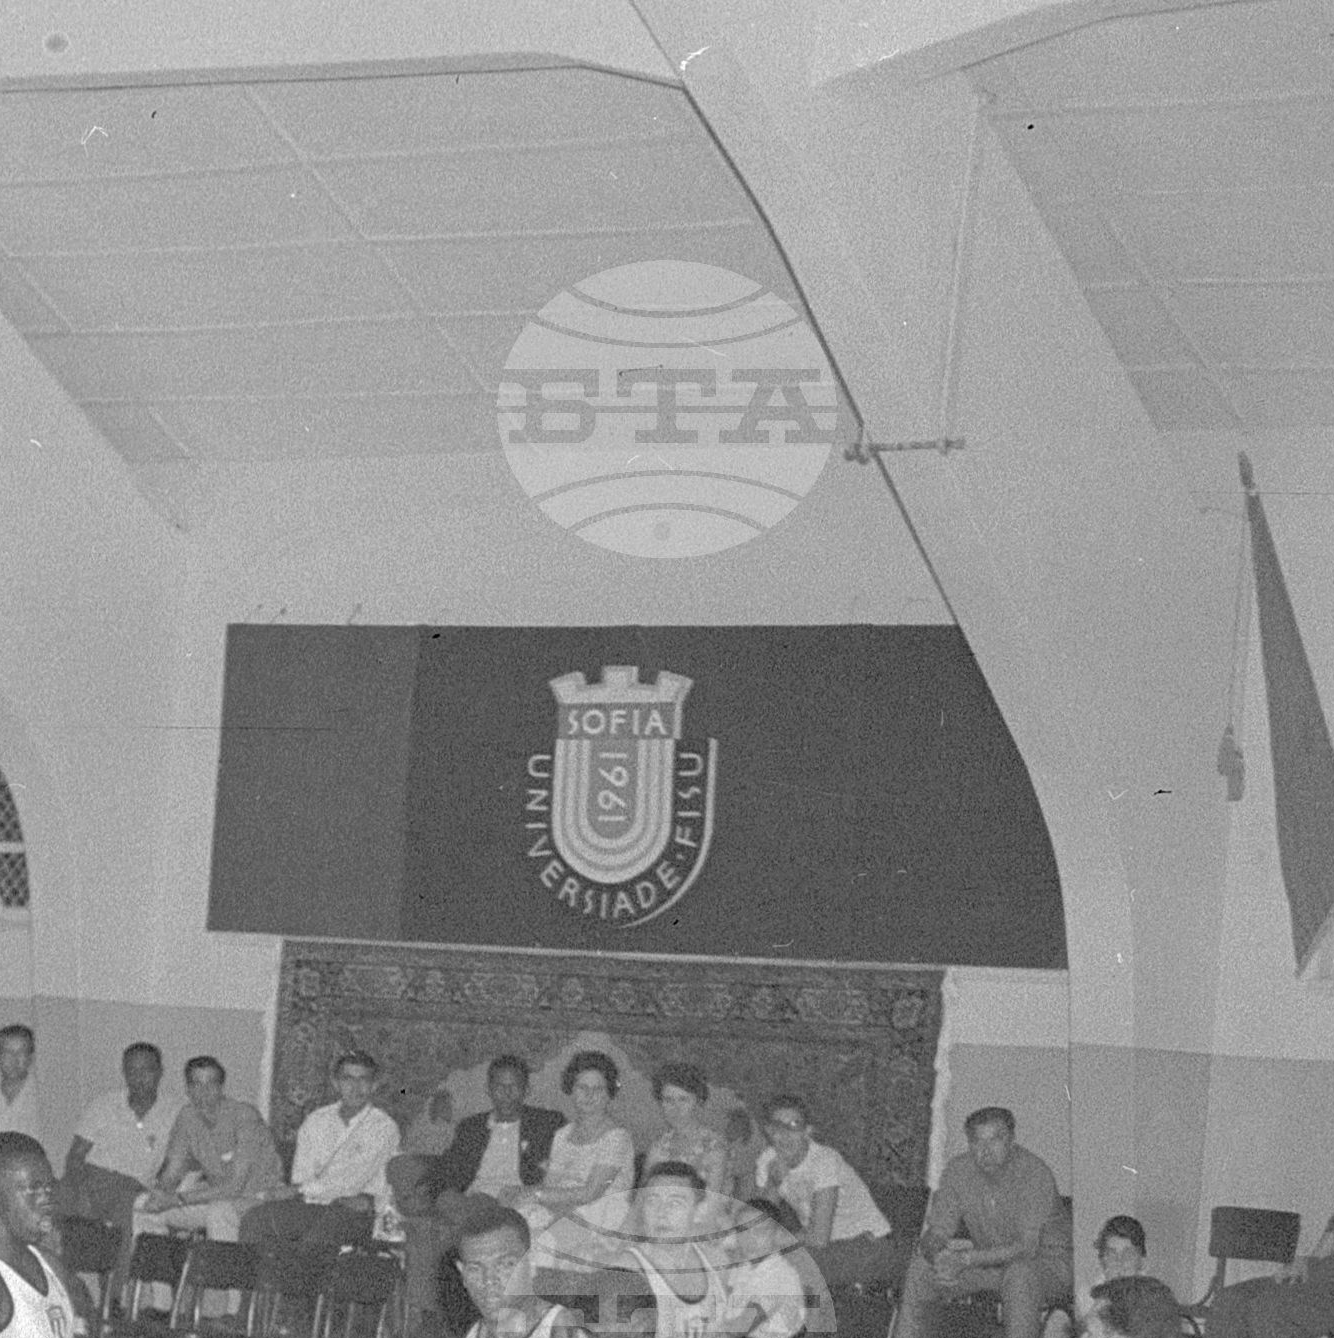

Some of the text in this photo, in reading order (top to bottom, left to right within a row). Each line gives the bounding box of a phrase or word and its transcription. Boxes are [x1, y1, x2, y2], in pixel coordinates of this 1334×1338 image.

[567, 708, 668, 736] SOFIA
[597, 752, 630, 822] 1961
[525, 752, 704, 919] UNIVERSIADE FISU
